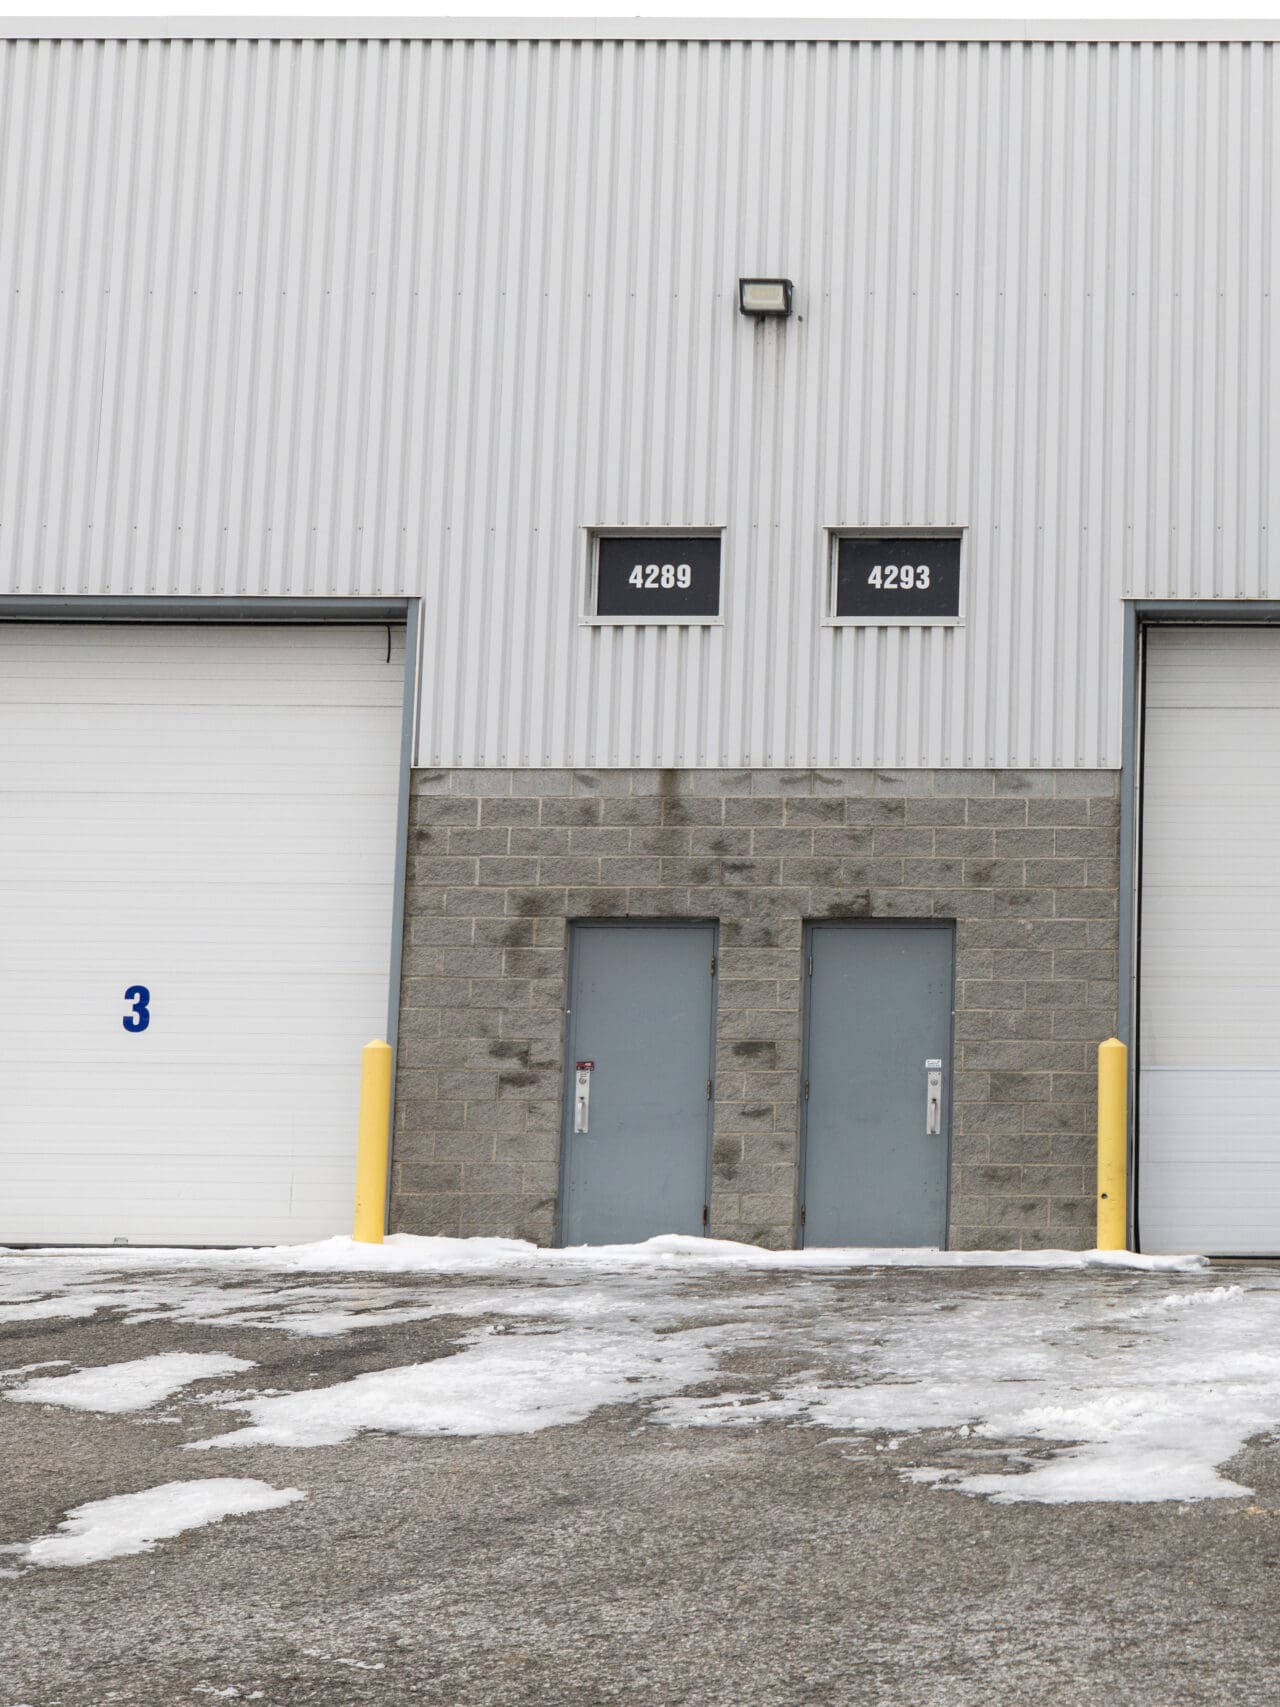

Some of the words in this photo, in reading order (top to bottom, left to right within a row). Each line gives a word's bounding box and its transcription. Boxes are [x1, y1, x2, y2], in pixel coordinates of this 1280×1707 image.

[628, 564, 692, 589] 4289
[867, 565, 930, 590] 4293
[122, 985, 151, 1033] 3
